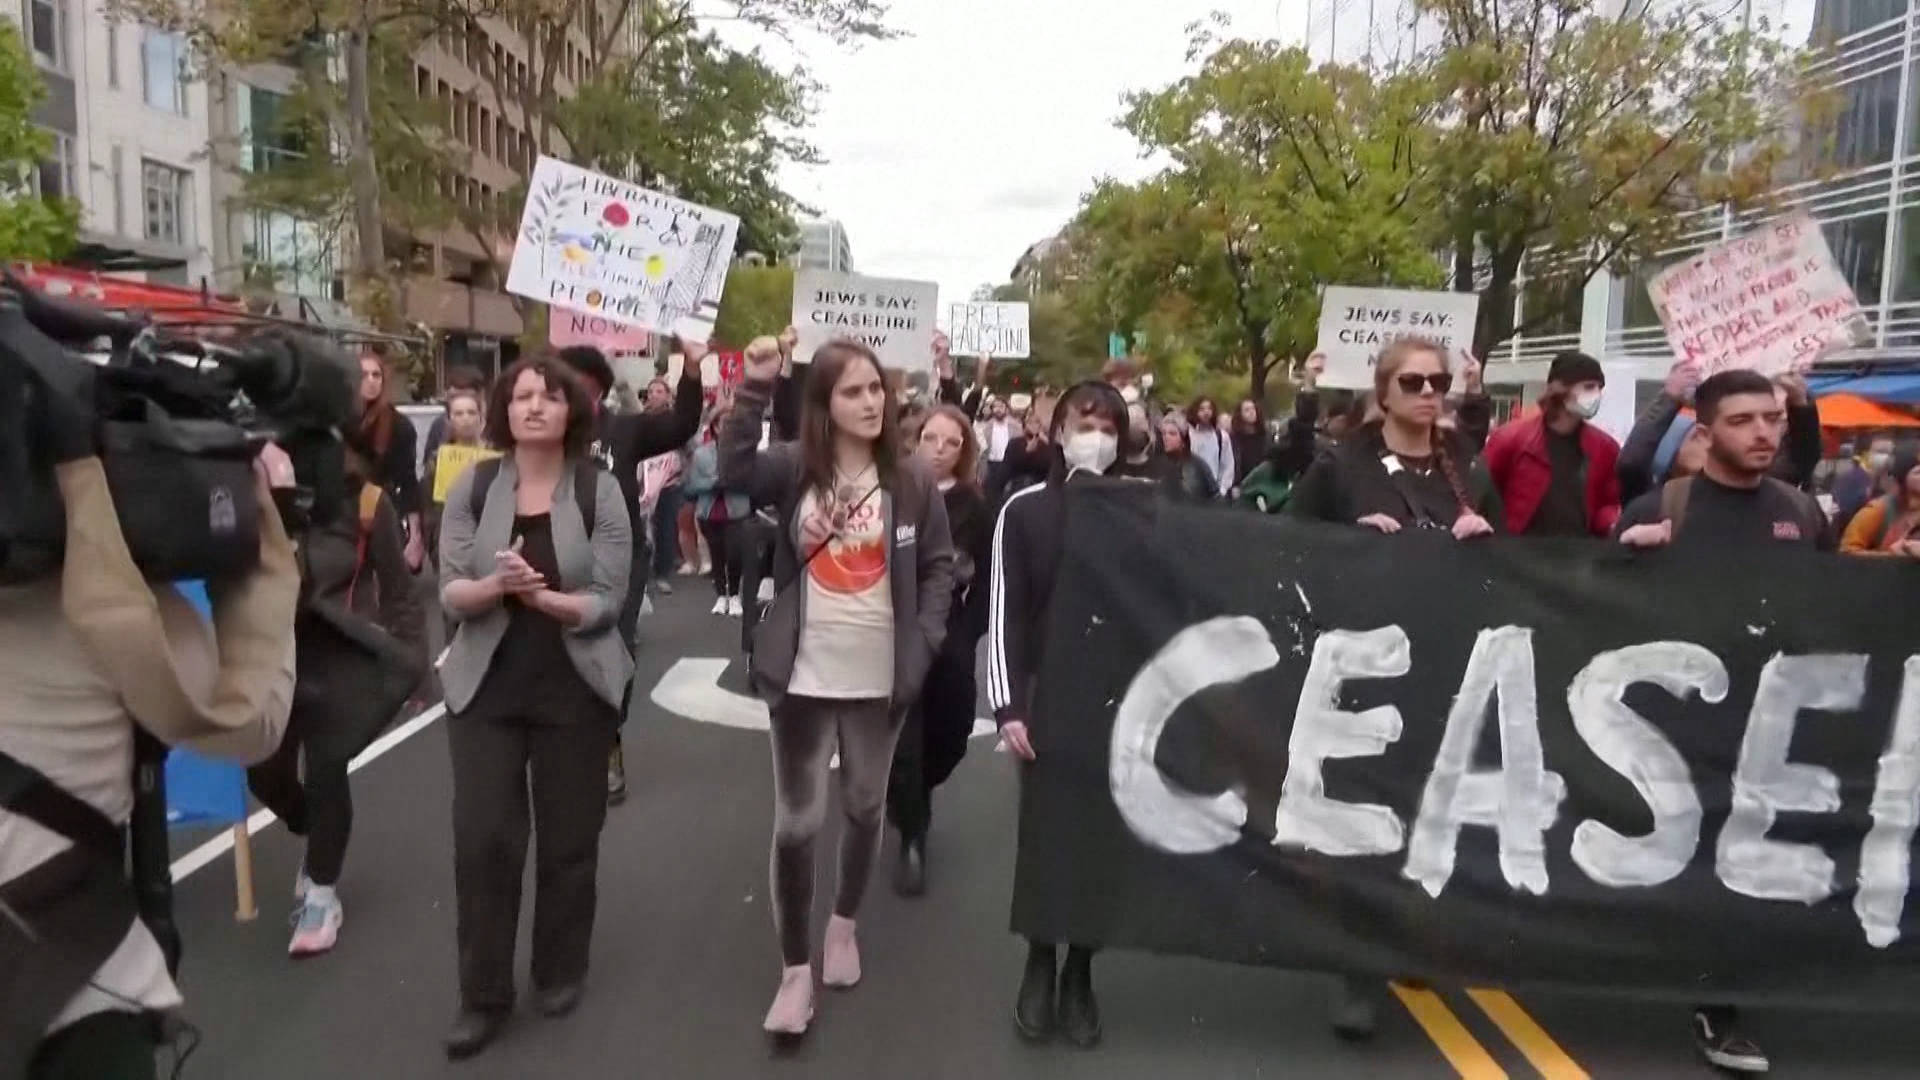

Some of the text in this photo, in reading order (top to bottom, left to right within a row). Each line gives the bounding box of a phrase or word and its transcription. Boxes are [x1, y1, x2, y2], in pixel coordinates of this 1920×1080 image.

[815, 291, 917, 311] JEWS SAY:
[811, 310, 917, 331] CEASEFIRE
[951, 303, 1009, 326] FREE
[1344, 307, 1453, 327] JEWS SAY:
[571, 315, 627, 335] NOW
[1681, 308, 1769, 359] REDDER
